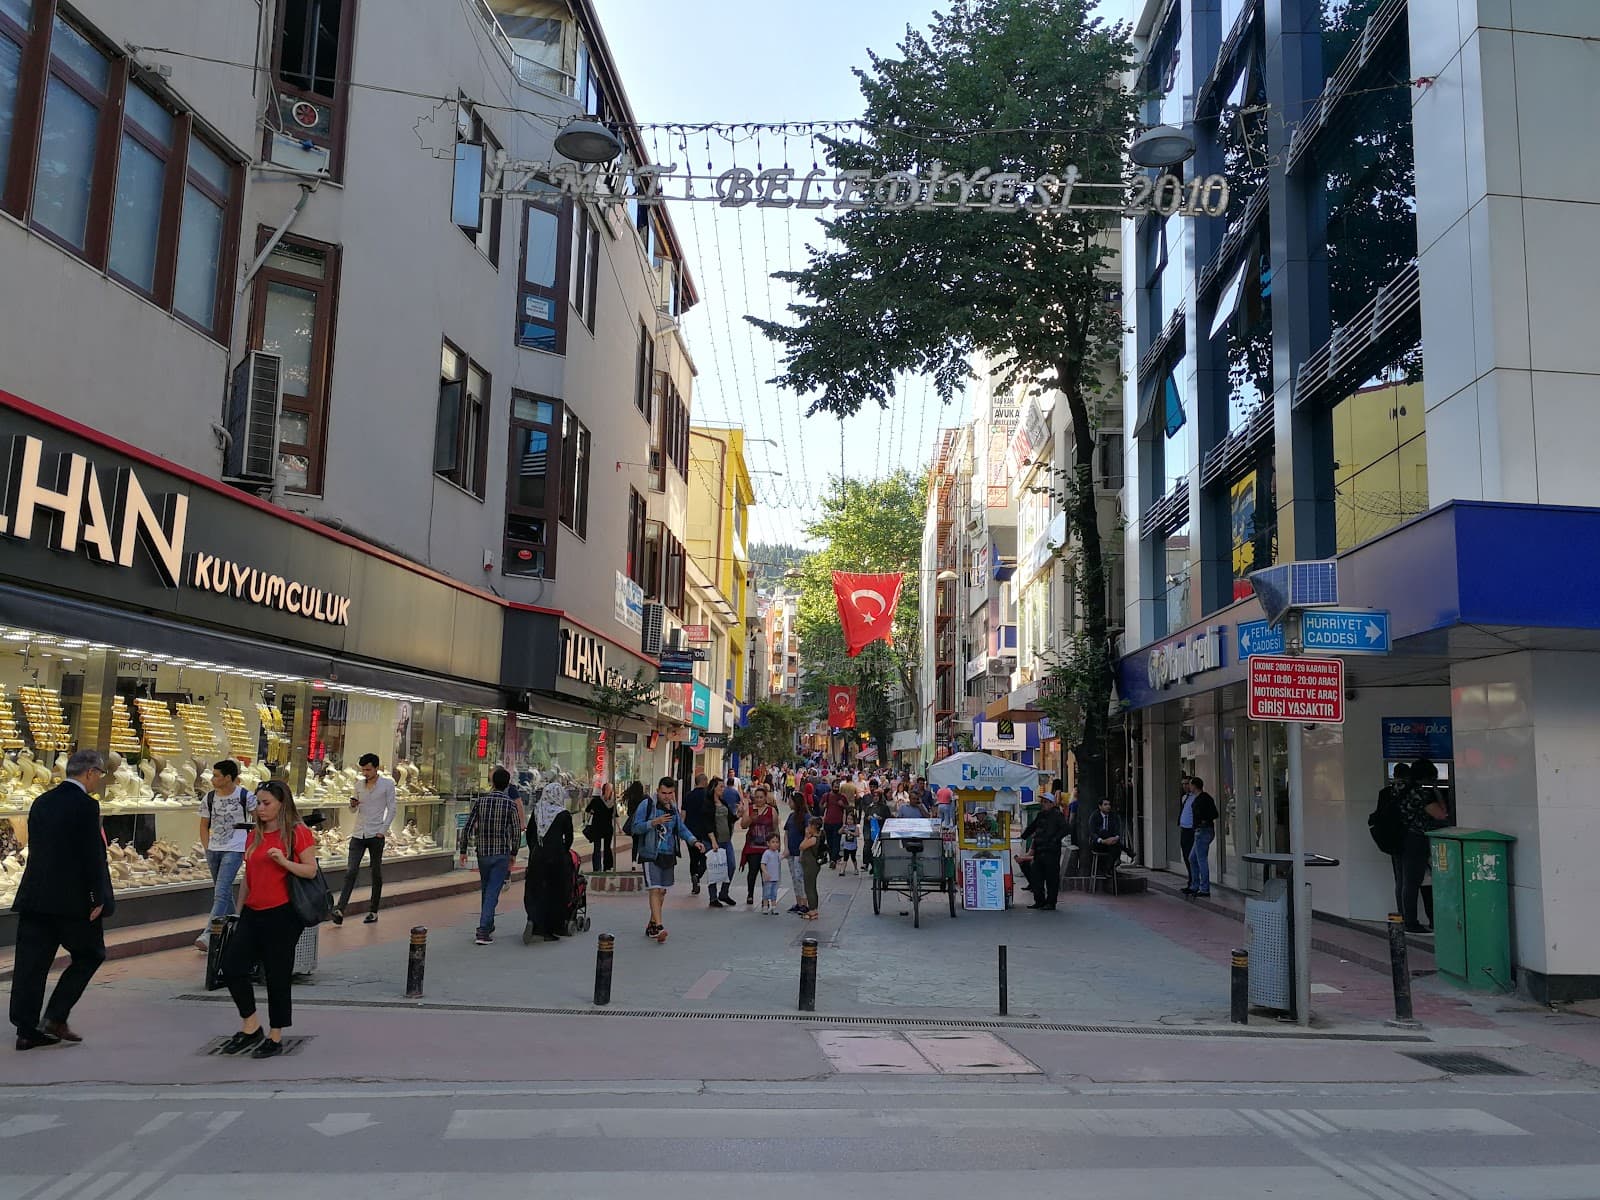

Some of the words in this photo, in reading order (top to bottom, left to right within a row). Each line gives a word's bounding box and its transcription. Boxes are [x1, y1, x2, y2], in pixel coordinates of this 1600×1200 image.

[715, 161, 1082, 213] BELEDİYESİ
[1124, 173, 1231, 217] 2010
[1306, 616, 1363, 630] HÜRRİYET
[1252, 636, 1281, 652] CADDESİ
[1307, 631, 1358, 645] CADDESİ
[1306, 665, 1327, 673] KARARI
[1328, 664, 1337, 674] İLE
[1254, 674, 1271, 683] SAAT
[1273, 674, 1292, 684] 10:00
[1297, 675, 1317, 685] 20:00
[1317, 676, 1338, 687] ARASI
[1254, 686, 1305, 699] MOTORSİKLET
[1306, 689, 1316, 699] VE
[1317, 689, 1338, 702] ARAÇ
[1258, 699, 1286, 717] GİRİŞİ
[1288, 701, 1334, 717] YASAKTIR
[979, 763, 1006, 777] İZMİT
